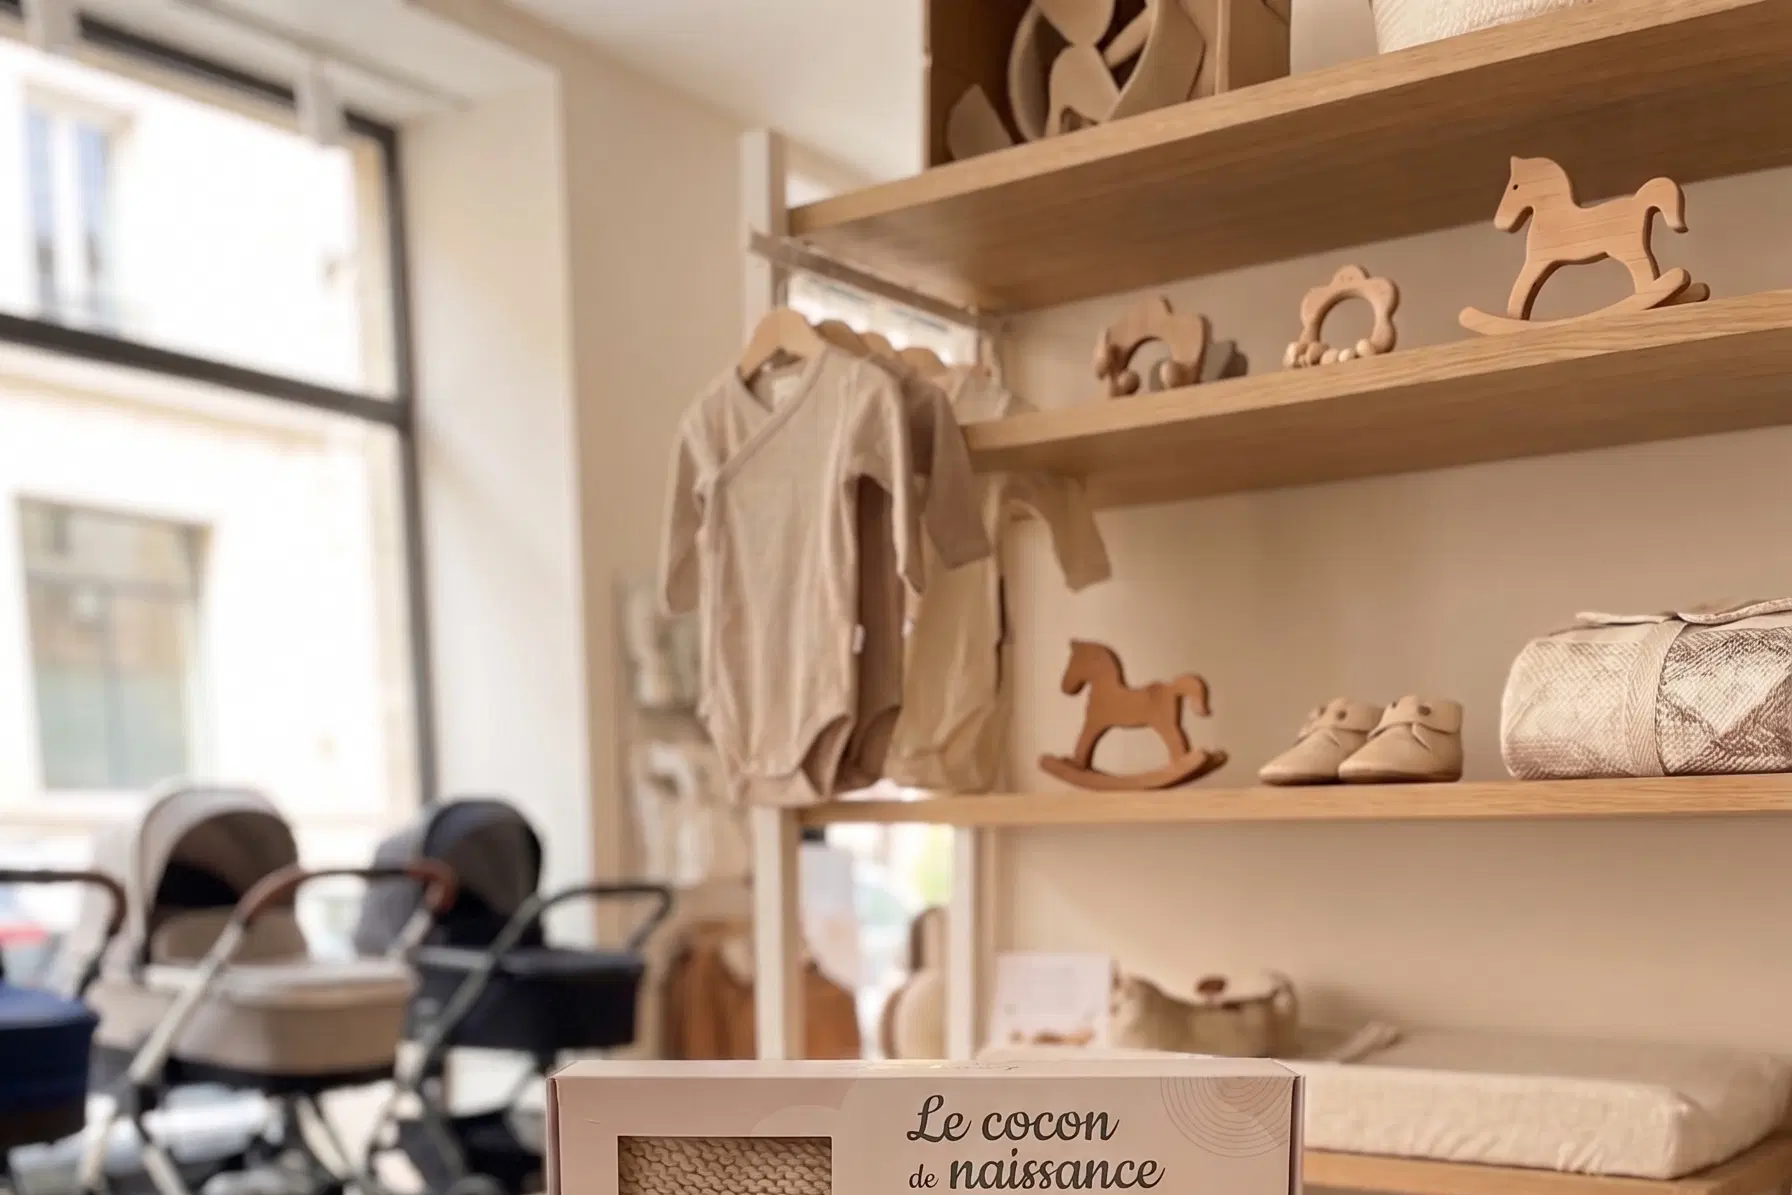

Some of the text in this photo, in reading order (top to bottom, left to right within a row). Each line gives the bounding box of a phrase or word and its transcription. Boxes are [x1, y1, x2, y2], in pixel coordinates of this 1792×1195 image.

[906, 1094, 1120, 1142] Le cocon
[908, 1148, 1166, 1190] de naissance
